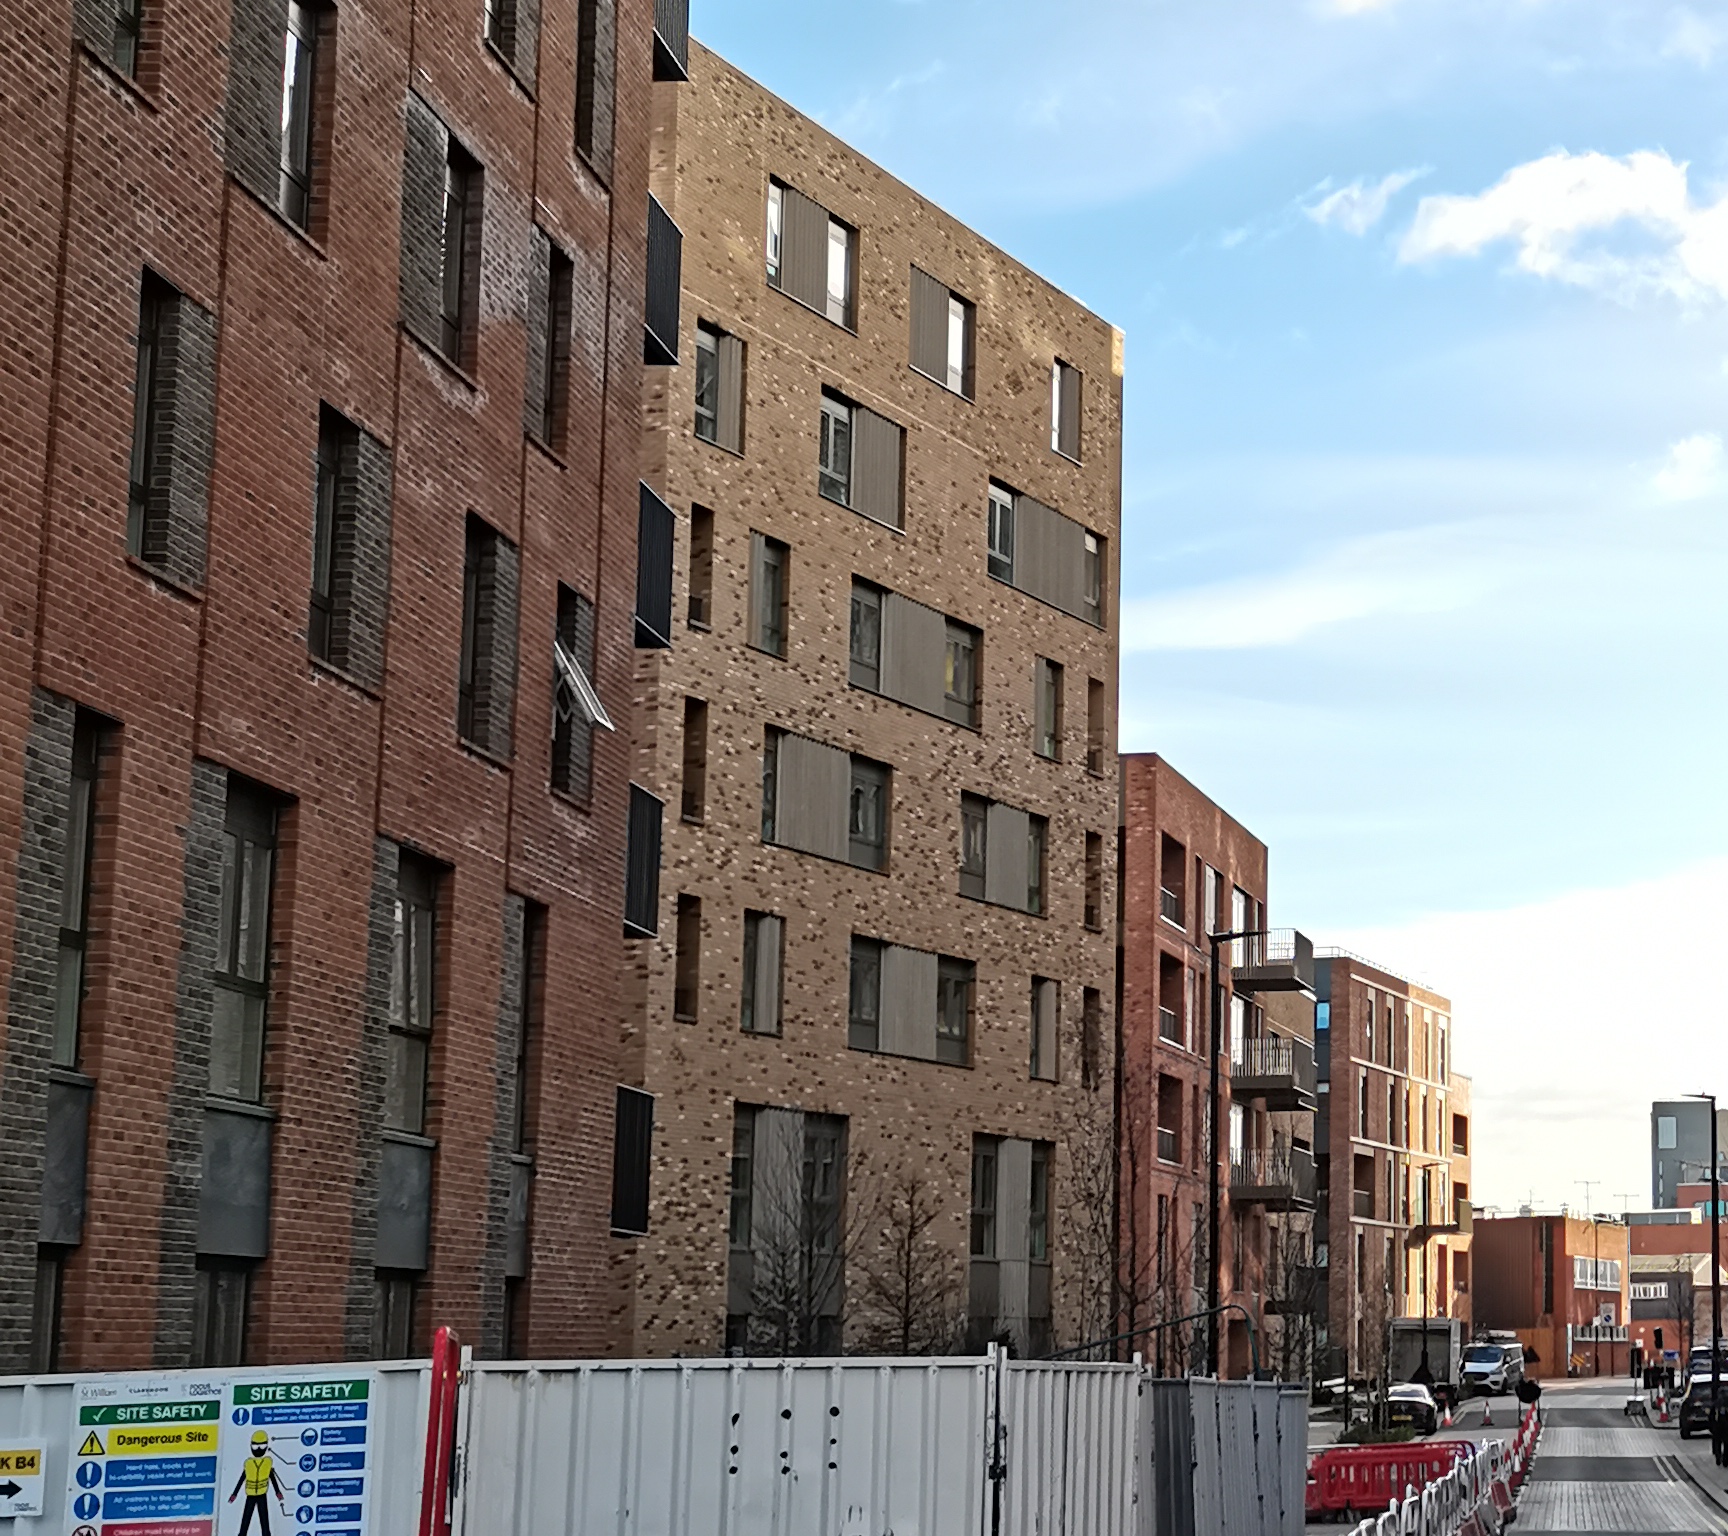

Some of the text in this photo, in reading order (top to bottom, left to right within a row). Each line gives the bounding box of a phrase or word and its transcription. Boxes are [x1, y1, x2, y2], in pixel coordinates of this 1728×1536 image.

[250, 1383, 353, 1402] SITE SAFETY
[116, 1404, 208, 1421] SITE SAFETY
[117, 1431, 209, 1448] Dangerous Site
[15, 1455, 36, 1470] B4
